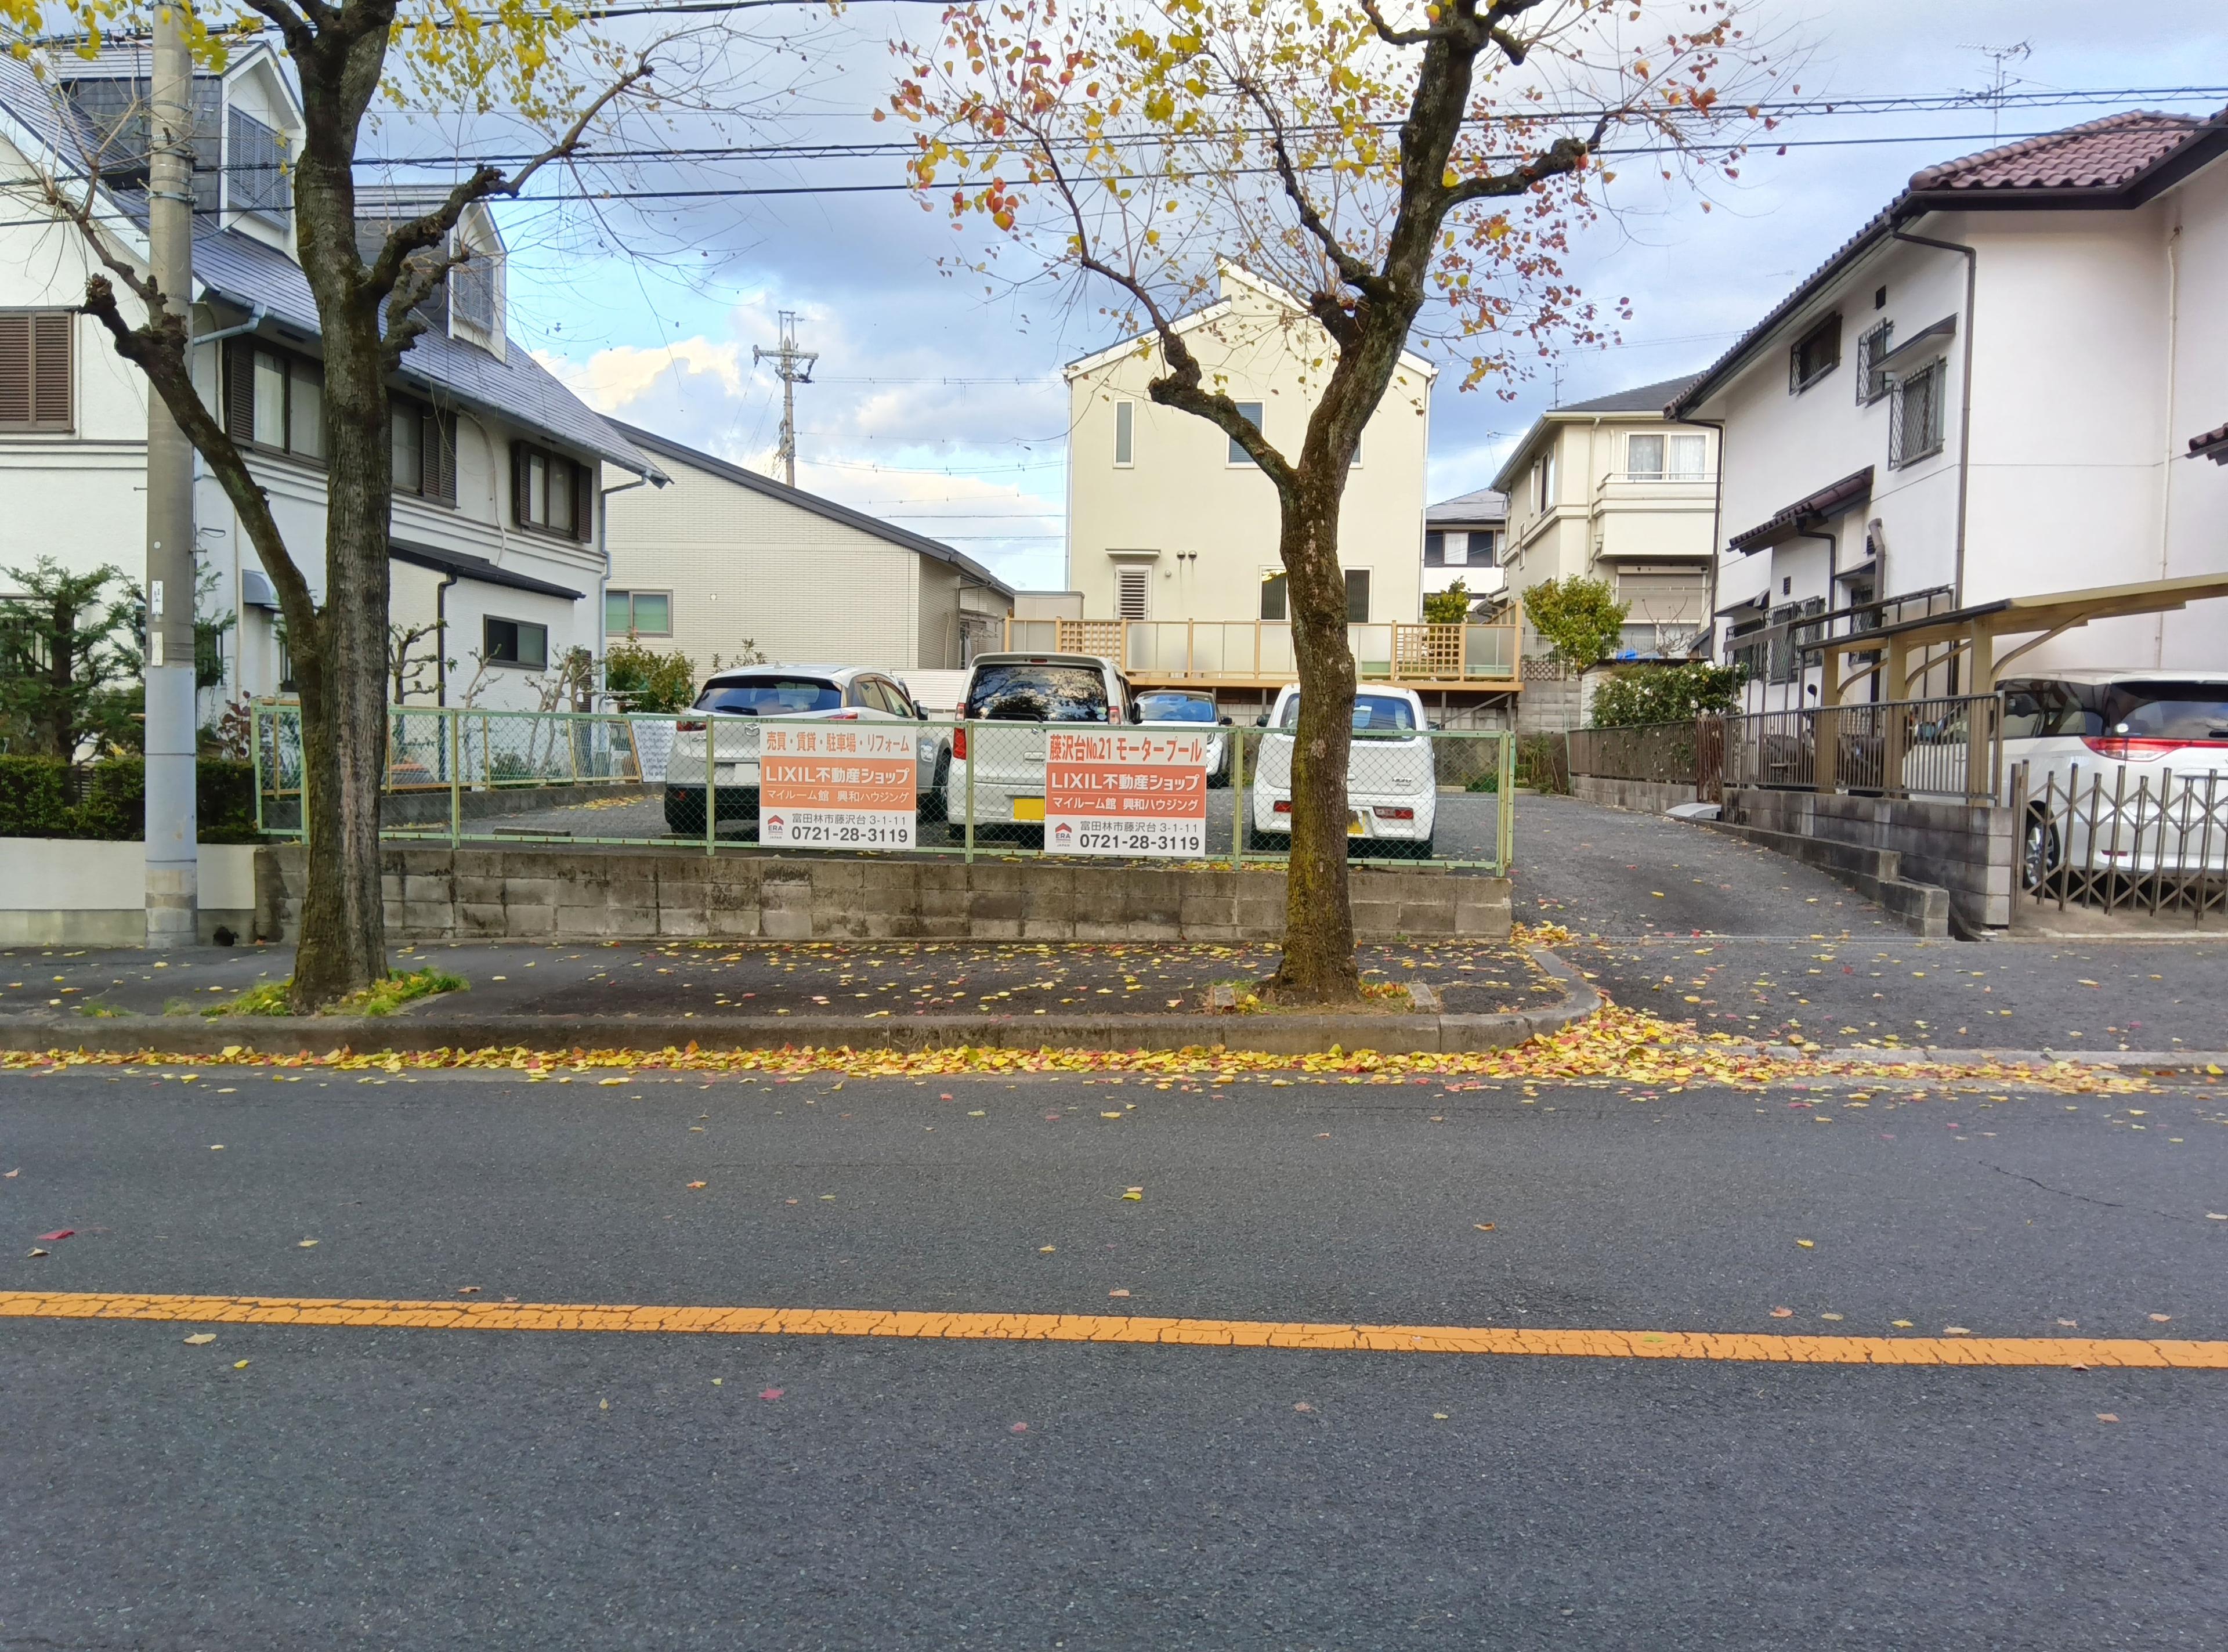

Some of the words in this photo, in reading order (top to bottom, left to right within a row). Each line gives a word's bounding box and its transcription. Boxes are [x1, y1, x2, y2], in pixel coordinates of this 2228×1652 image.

[1116, 736, 1203, 762] モータープール
[765, 766, 910, 785] LIXIL不動産ショップ
[1051, 772, 1200, 791] LIXIL不動産ショップ
[767, 790, 829, 802] マイルーム館
[837, 791, 910, 804] 興和ハウジング
[1052, 797, 1117, 810] マイルーム館
[1123, 798, 1199, 811] 興和ハウジング
[792, 814, 866, 825] 富田林市藤沢台
[869, 815, 906, 825] 3-1-11
[1080, 821, 1156, 833] 富田林市藤沢台
[1160, 823, 1198, 833] 3-1-11
[791, 826, 908, 843] 0721-28-3119
[1080, 834, 1199, 851] 0721-28-3119
